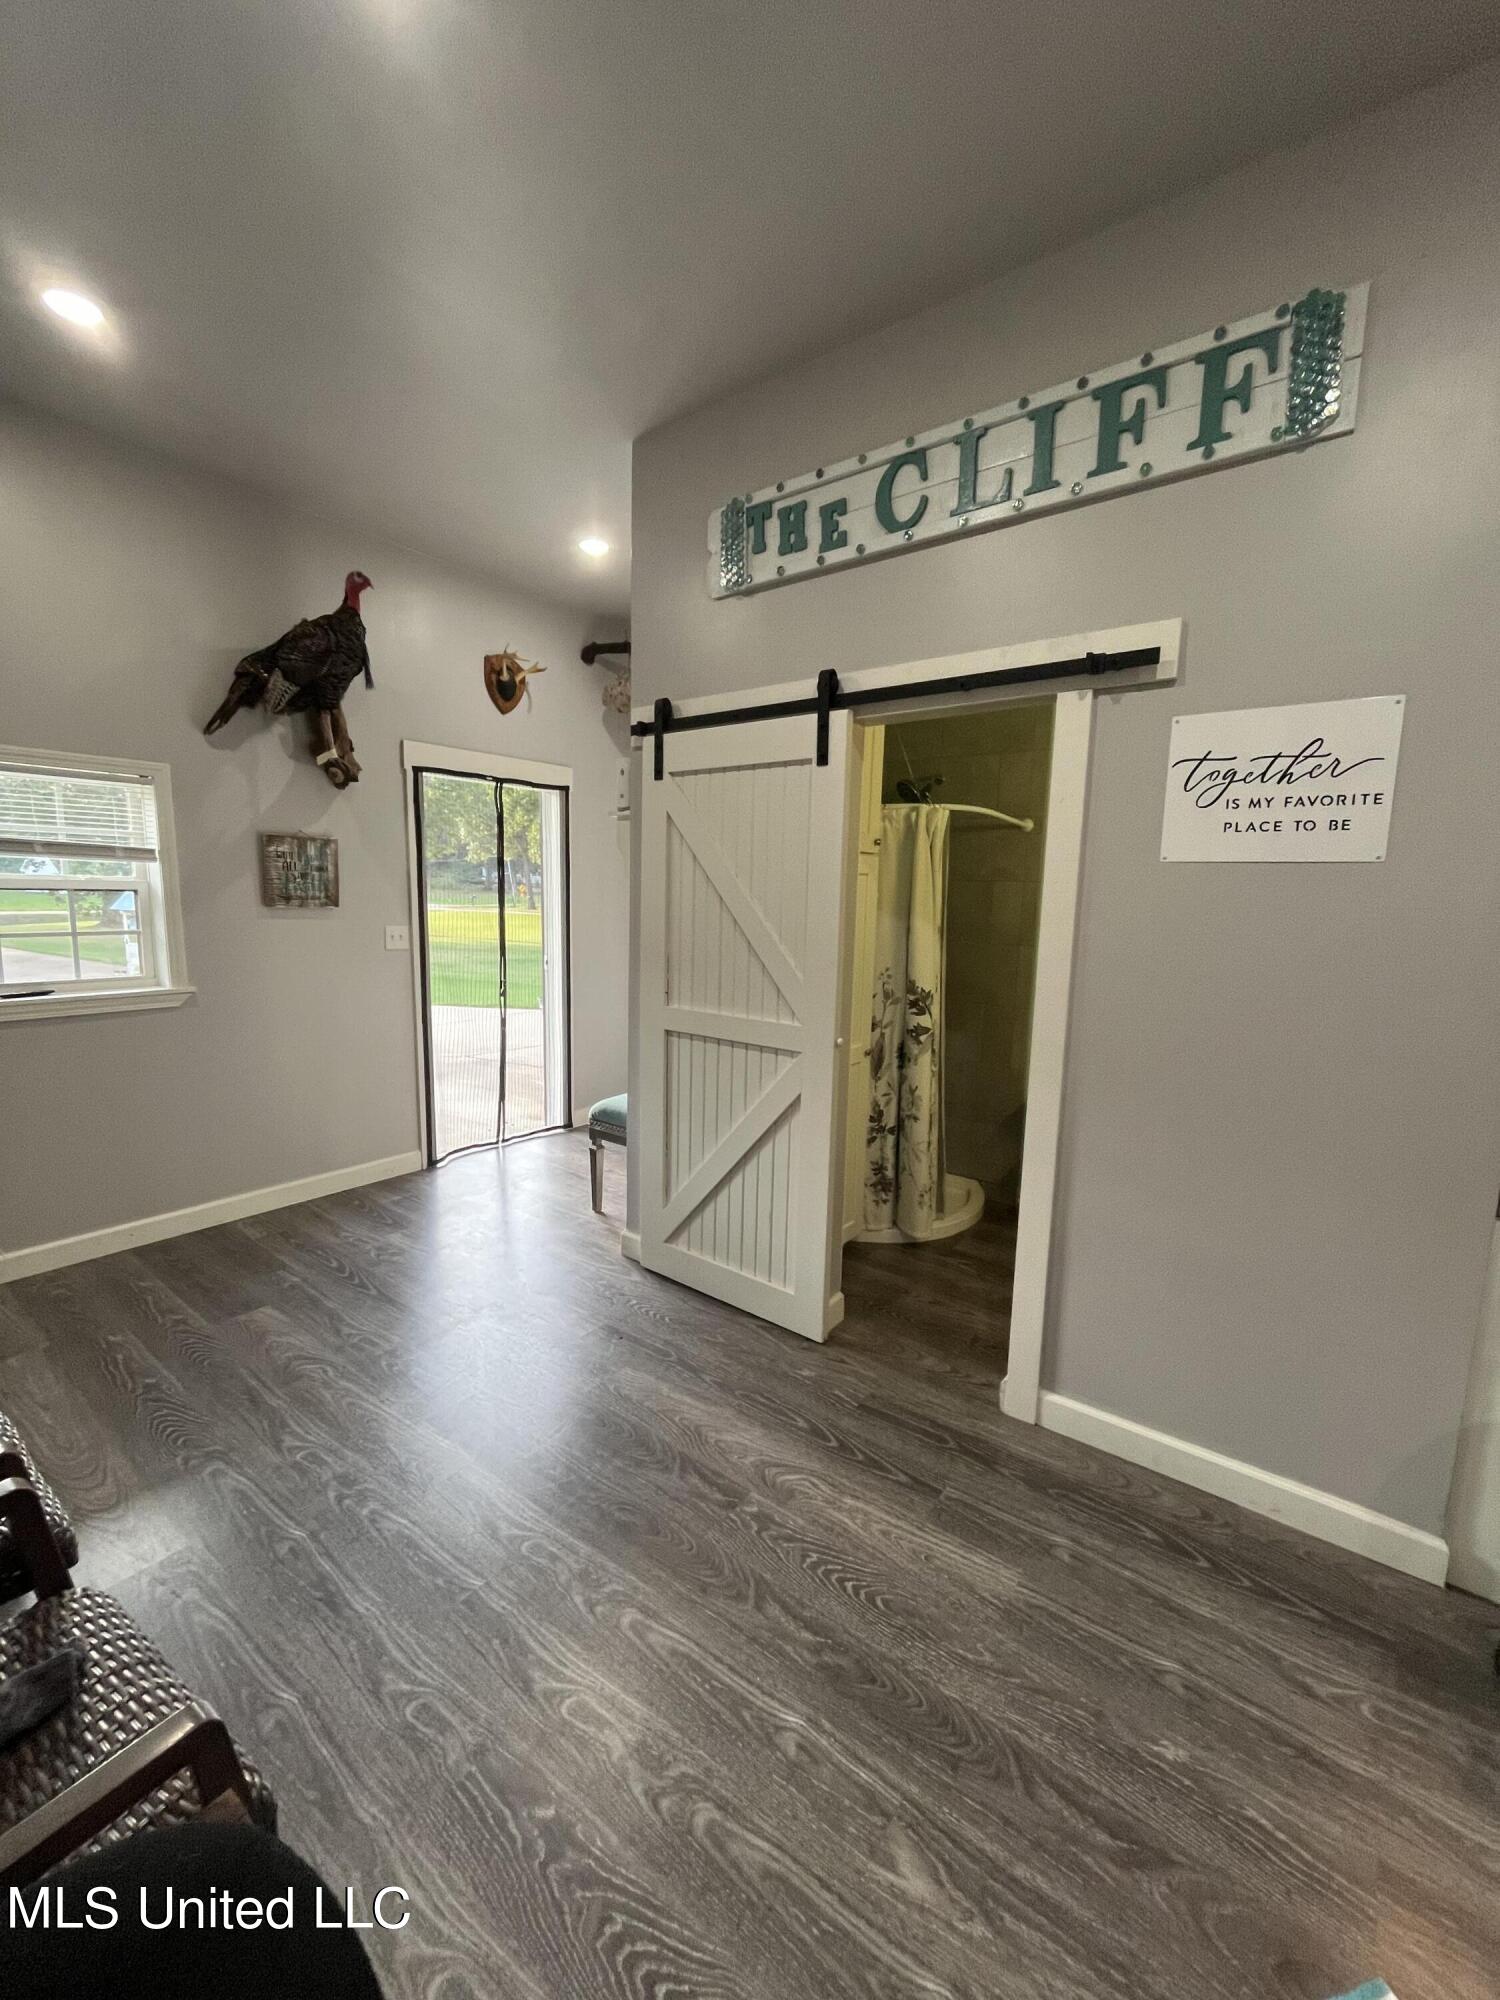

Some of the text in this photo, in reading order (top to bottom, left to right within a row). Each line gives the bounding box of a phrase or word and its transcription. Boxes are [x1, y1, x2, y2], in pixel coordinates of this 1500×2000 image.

[746, 327, 1288, 554] THE CLIFF
[1172, 738, 1385, 808] together
[1225, 793, 1384, 809] IS MY FAVORITE
[1224, 819, 1352, 833] PLACE TO BE
